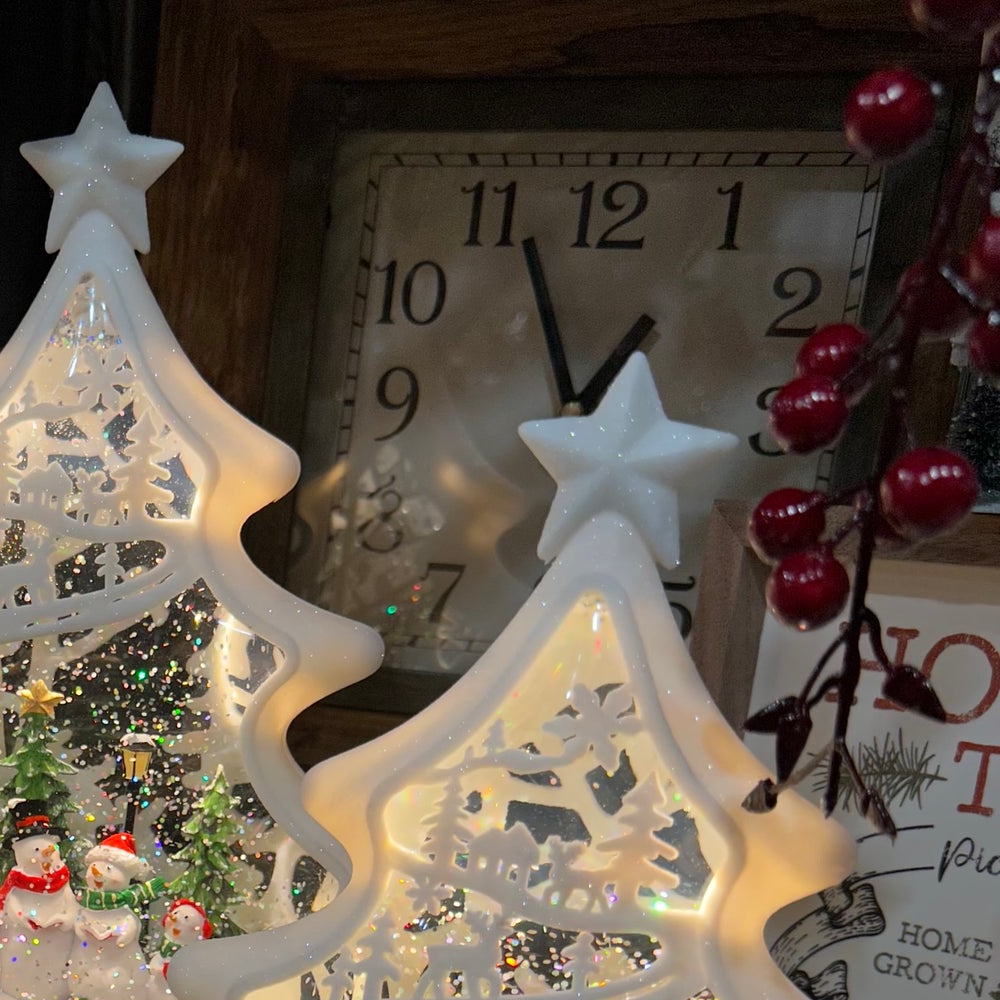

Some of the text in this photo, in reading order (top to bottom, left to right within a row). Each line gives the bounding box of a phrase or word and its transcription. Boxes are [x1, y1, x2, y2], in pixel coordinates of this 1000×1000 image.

[460, 180, 517, 247] 11
[569, 180, 649, 250] 12
[717, 181, 744, 251] 1
[374, 260, 447, 326] 10
[764, 266, 822, 338] 2
[374, 366, 420, 442] 9
[419, 562, 467, 623] 7
[873, 952, 988, 998] GROWN
[897, 921, 993, 963] HOME
